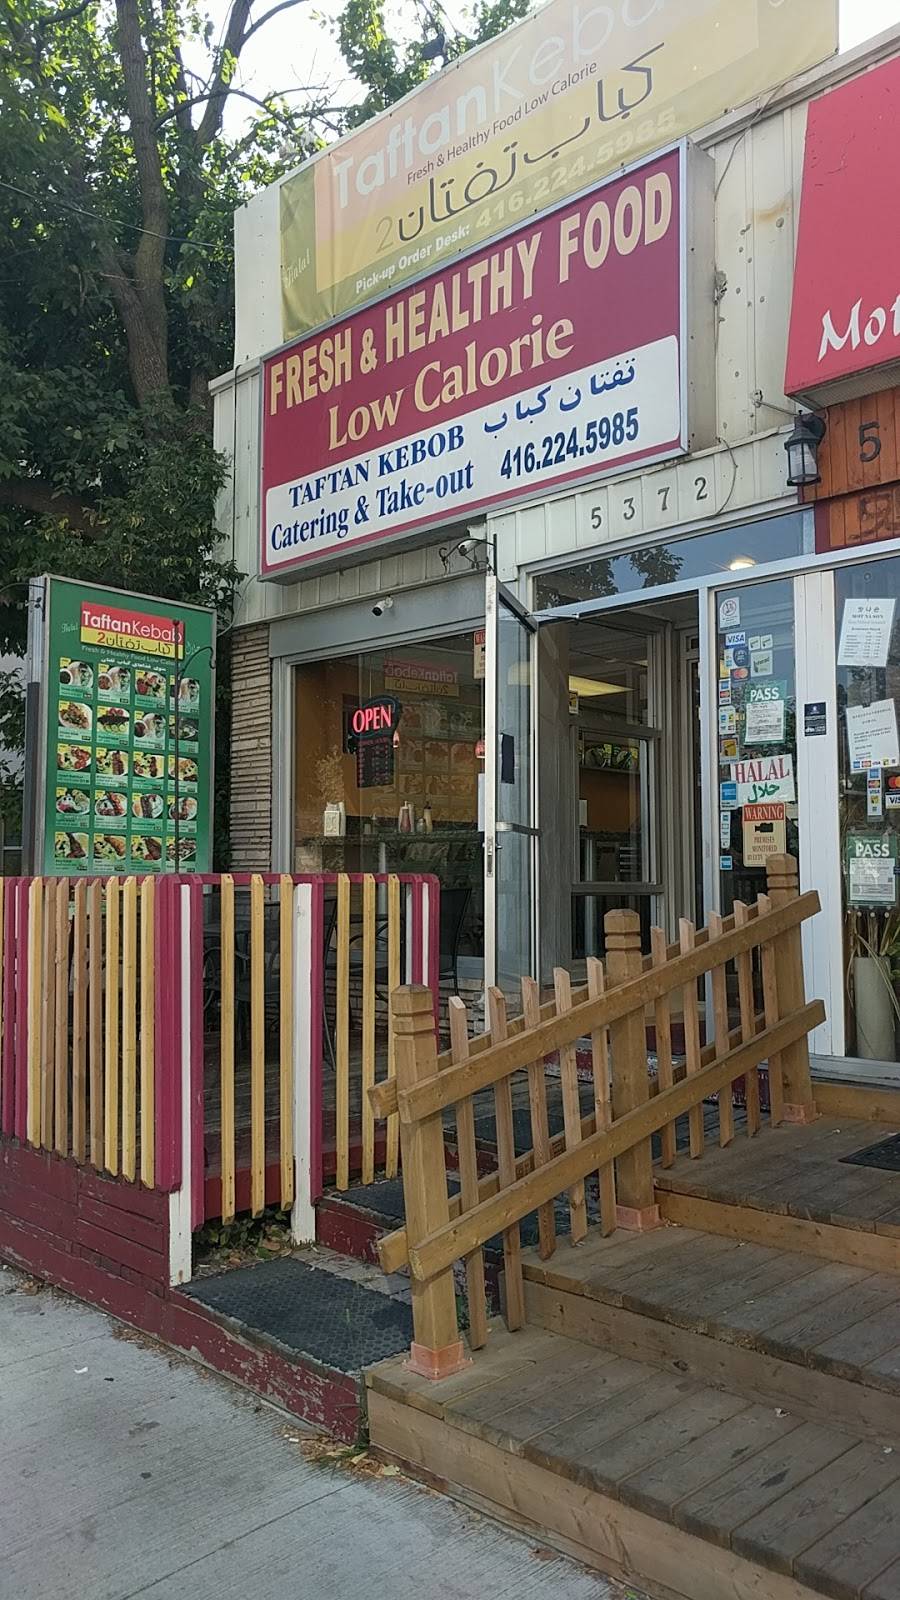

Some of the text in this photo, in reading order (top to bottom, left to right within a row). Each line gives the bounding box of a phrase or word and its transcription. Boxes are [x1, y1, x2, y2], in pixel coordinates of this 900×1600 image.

[406, 60, 597, 185] Fresh & Healthy Food Low Calorie
[355, 264, 396, 294] Pick-up
[398, 244, 432, 270] Order
[435, 222, 471, 250] Desk:
[269, 171, 672, 416] FRESH & HEALTHY FOOD
[327, 314, 575, 451] Low Calorie
[500, 407, 639, 480] 416.224.5985
[858, 421, 882, 462] 5
[289, 424, 465, 509] TAFTAN KEBOB
[271, 460, 474, 551] Catering & Take-out
[82, 610, 182, 642] TaftanKebab
[726, 634, 745, 643] VISA
[751, 687, 780, 702] PASS
[353, 704, 391, 733] OPEN
[734, 757, 790, 784] HALAL
[747, 782, 780, 803] حلال
[744, 805, 783, 820] WARNING
[854, 843, 890, 857] PASS
